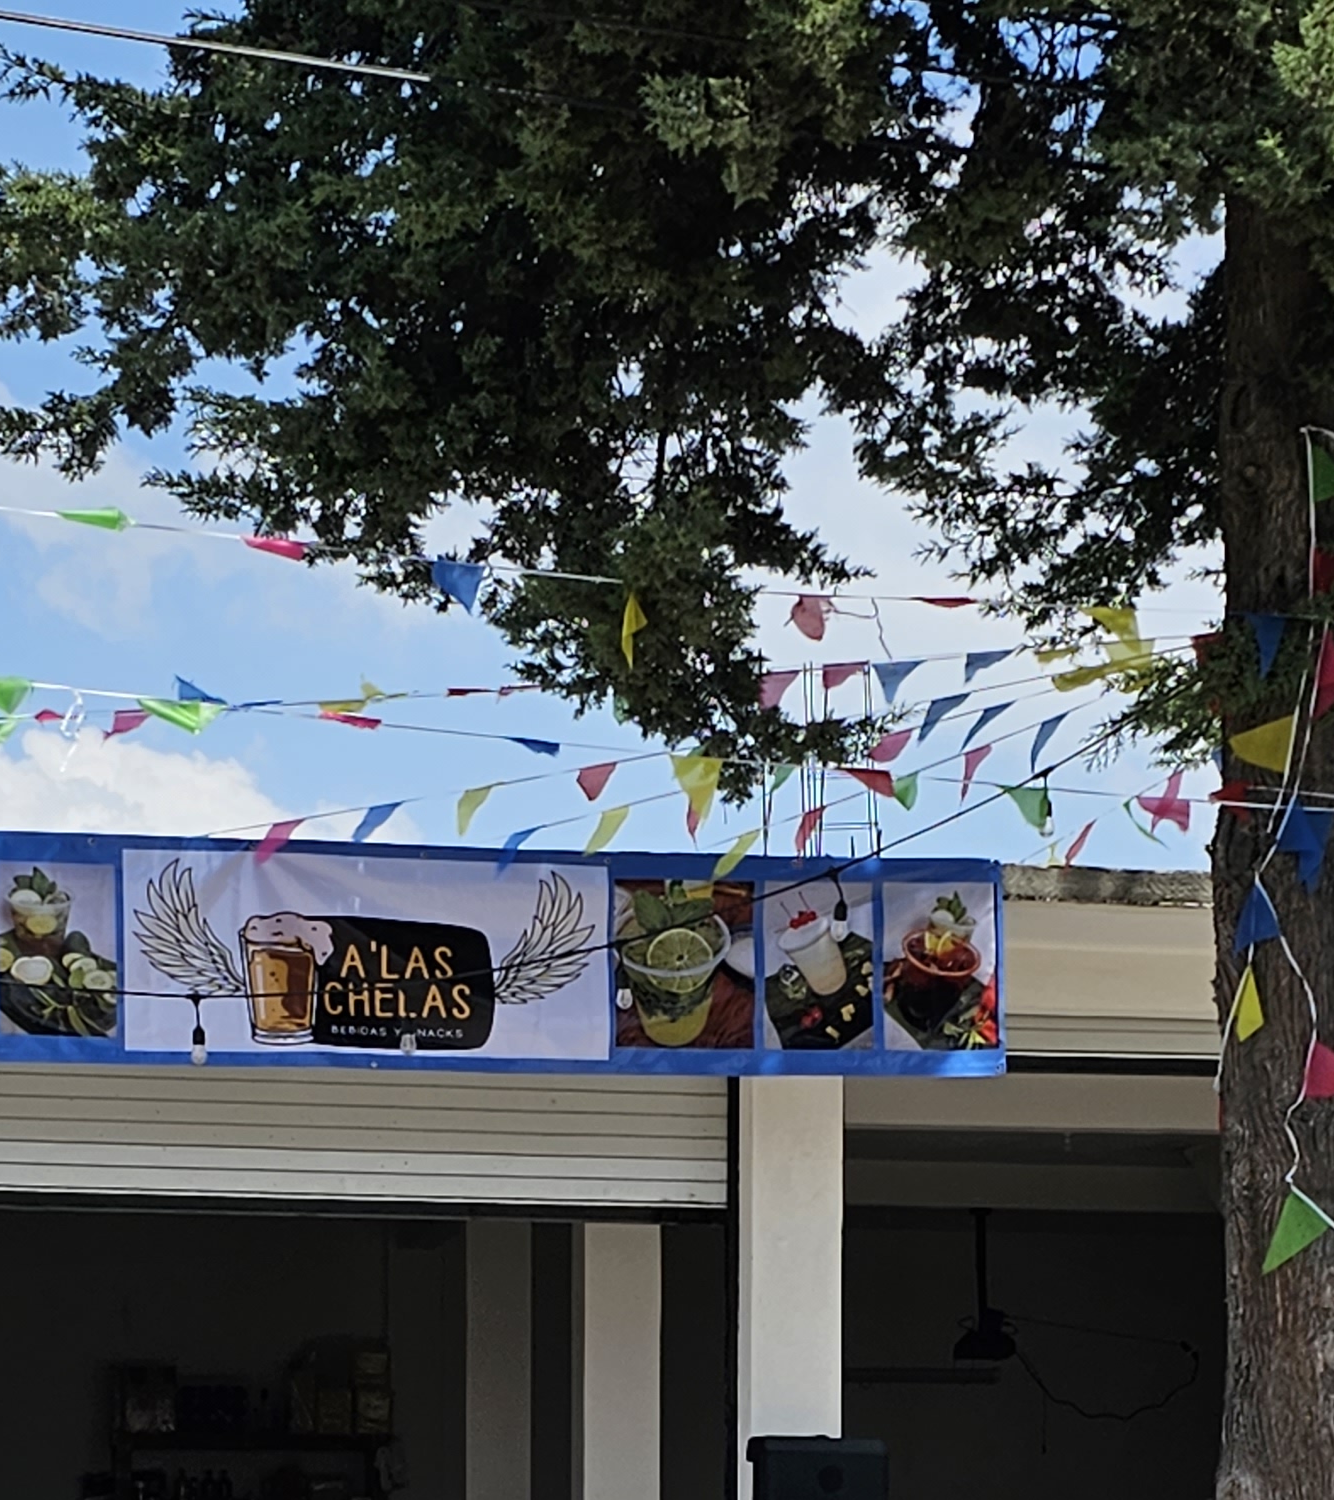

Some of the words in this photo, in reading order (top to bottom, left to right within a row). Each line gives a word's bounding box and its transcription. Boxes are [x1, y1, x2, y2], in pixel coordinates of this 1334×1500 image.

[339, 940, 454, 980] A'LAS
[323, 981, 472, 1020] CHELAS
[409, 1028, 465, 1040] NACKS
